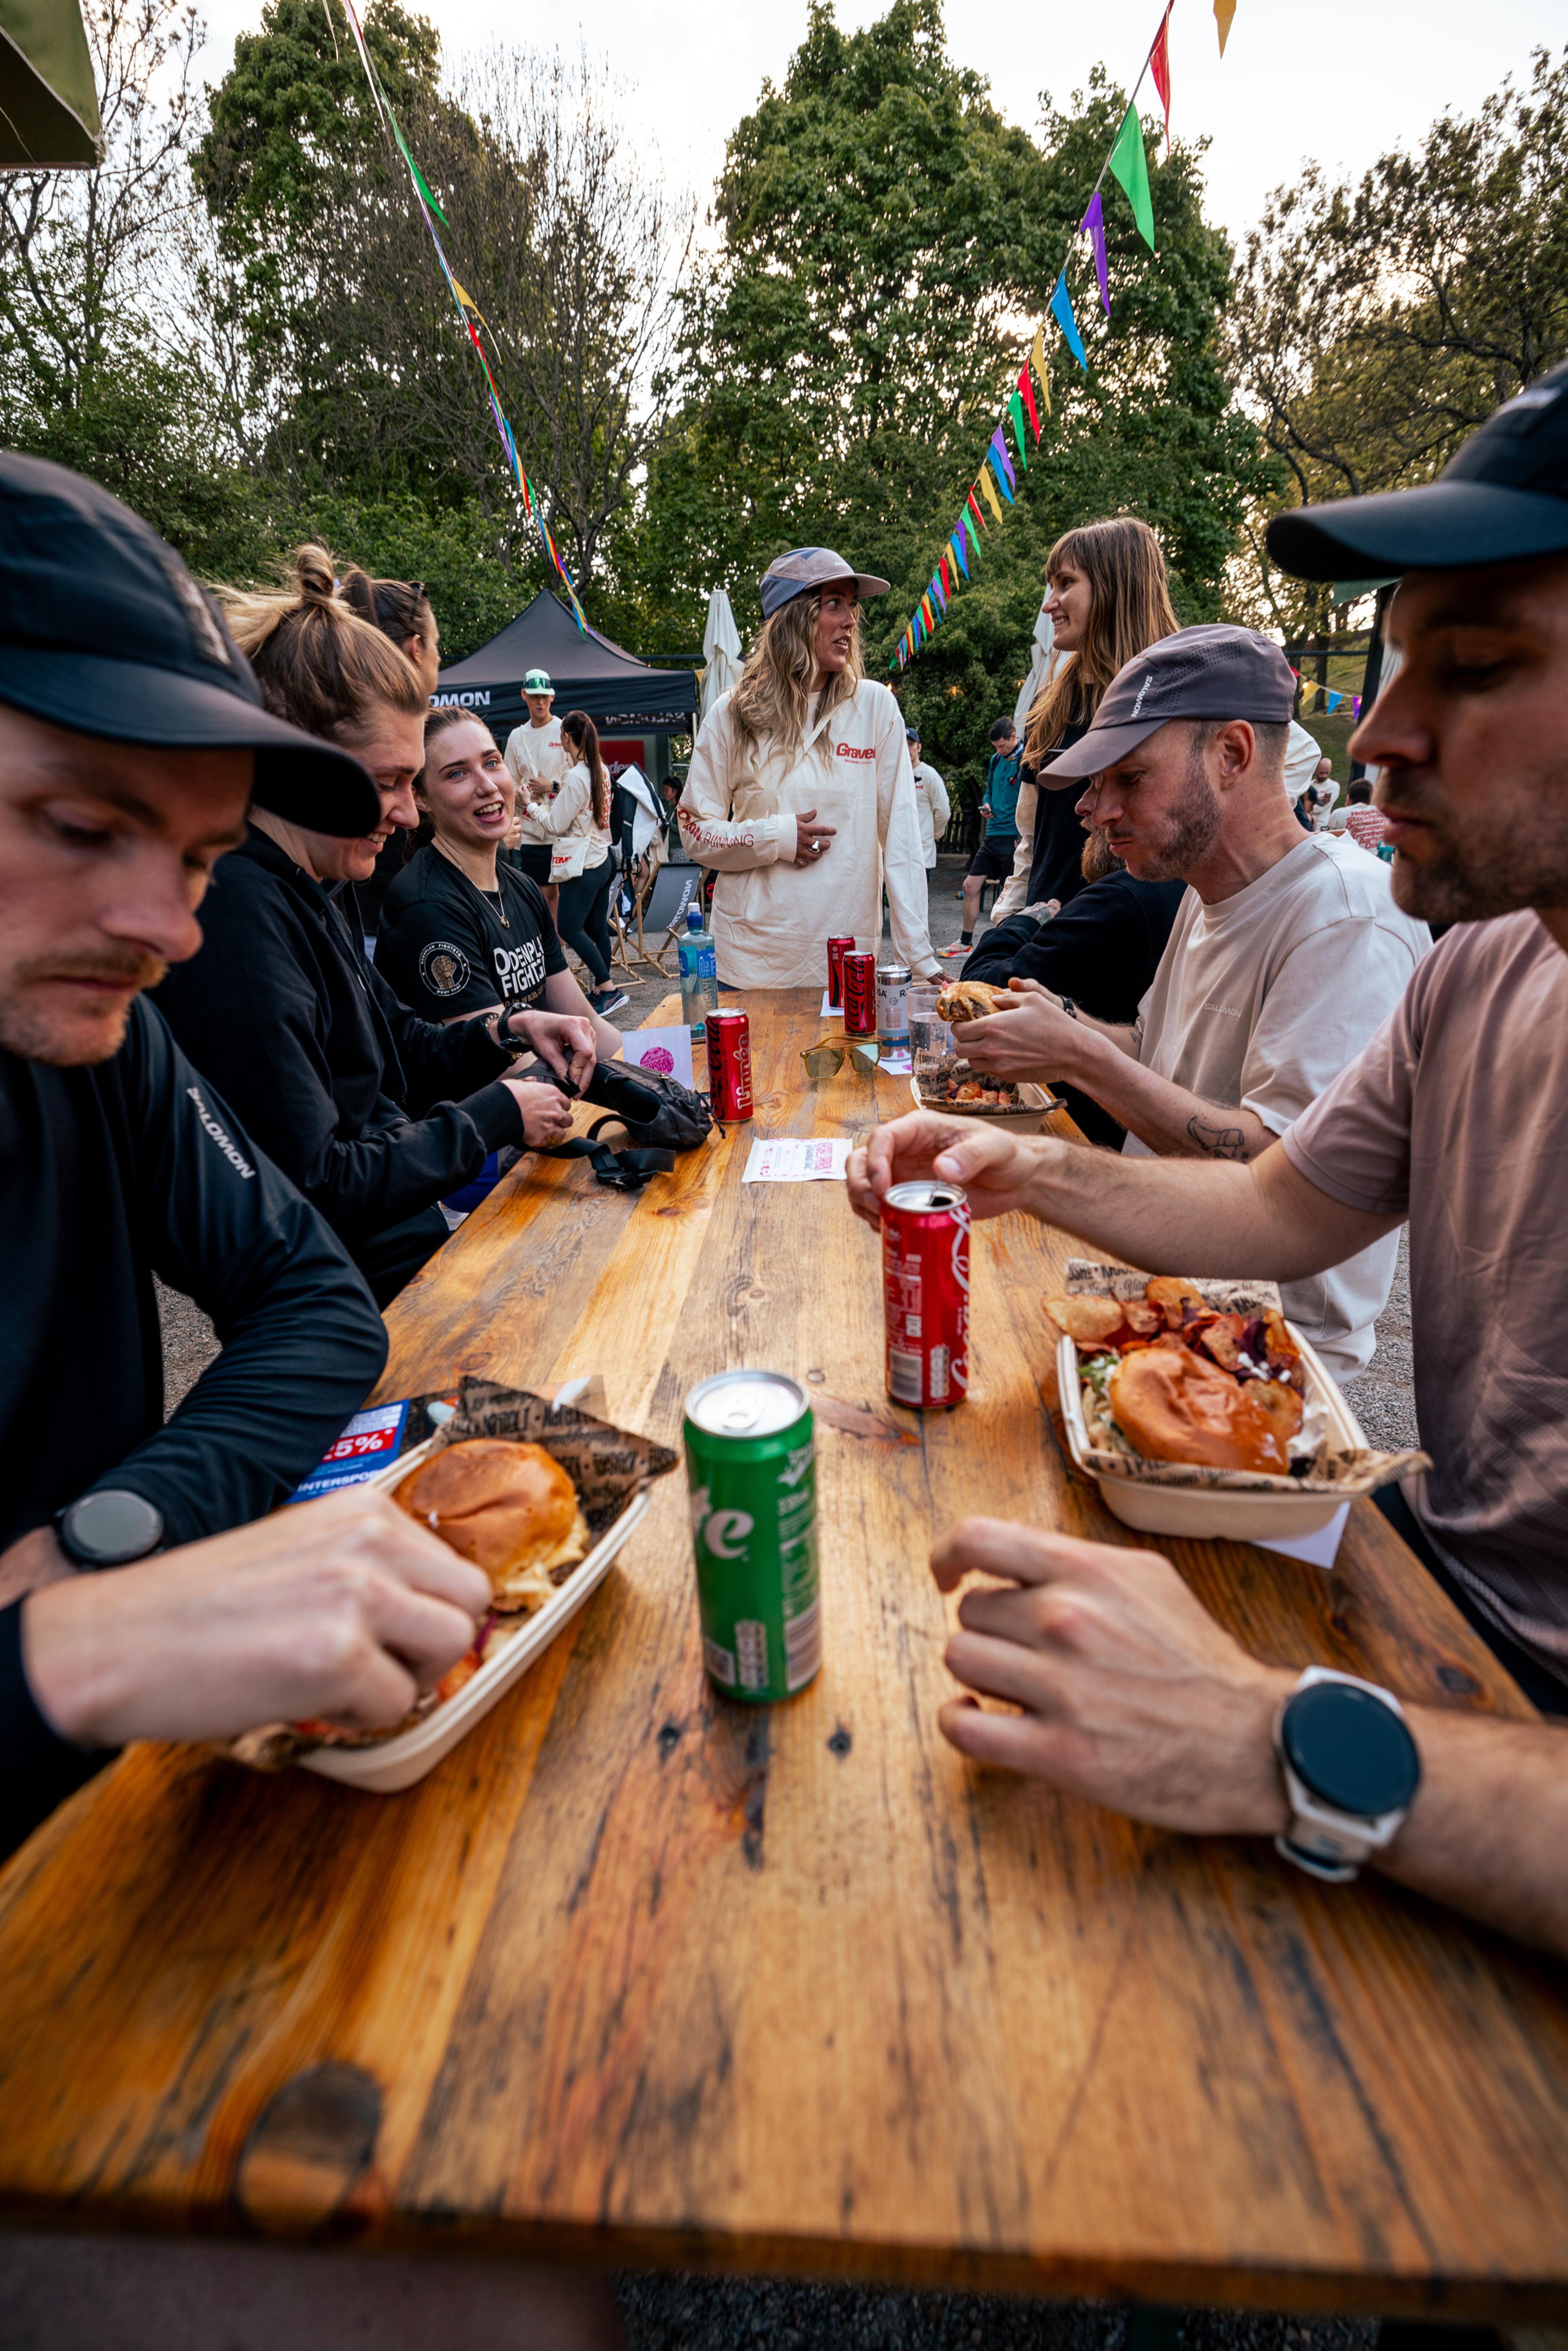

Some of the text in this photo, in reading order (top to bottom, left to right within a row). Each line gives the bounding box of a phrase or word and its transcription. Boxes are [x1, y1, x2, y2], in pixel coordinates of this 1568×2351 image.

[428, 691, 490, 707] OMON
[1131, 675, 1153, 717] SALOMON
[703, 831, 754, 848] RUNNING
[439, 943, 462, 957] FIGHTGYM
[493, 934, 544, 976] ODENPLA
[1203, 1003, 1242, 1018] SALOMON
[187, 1087, 256, 1179] SALOMON
